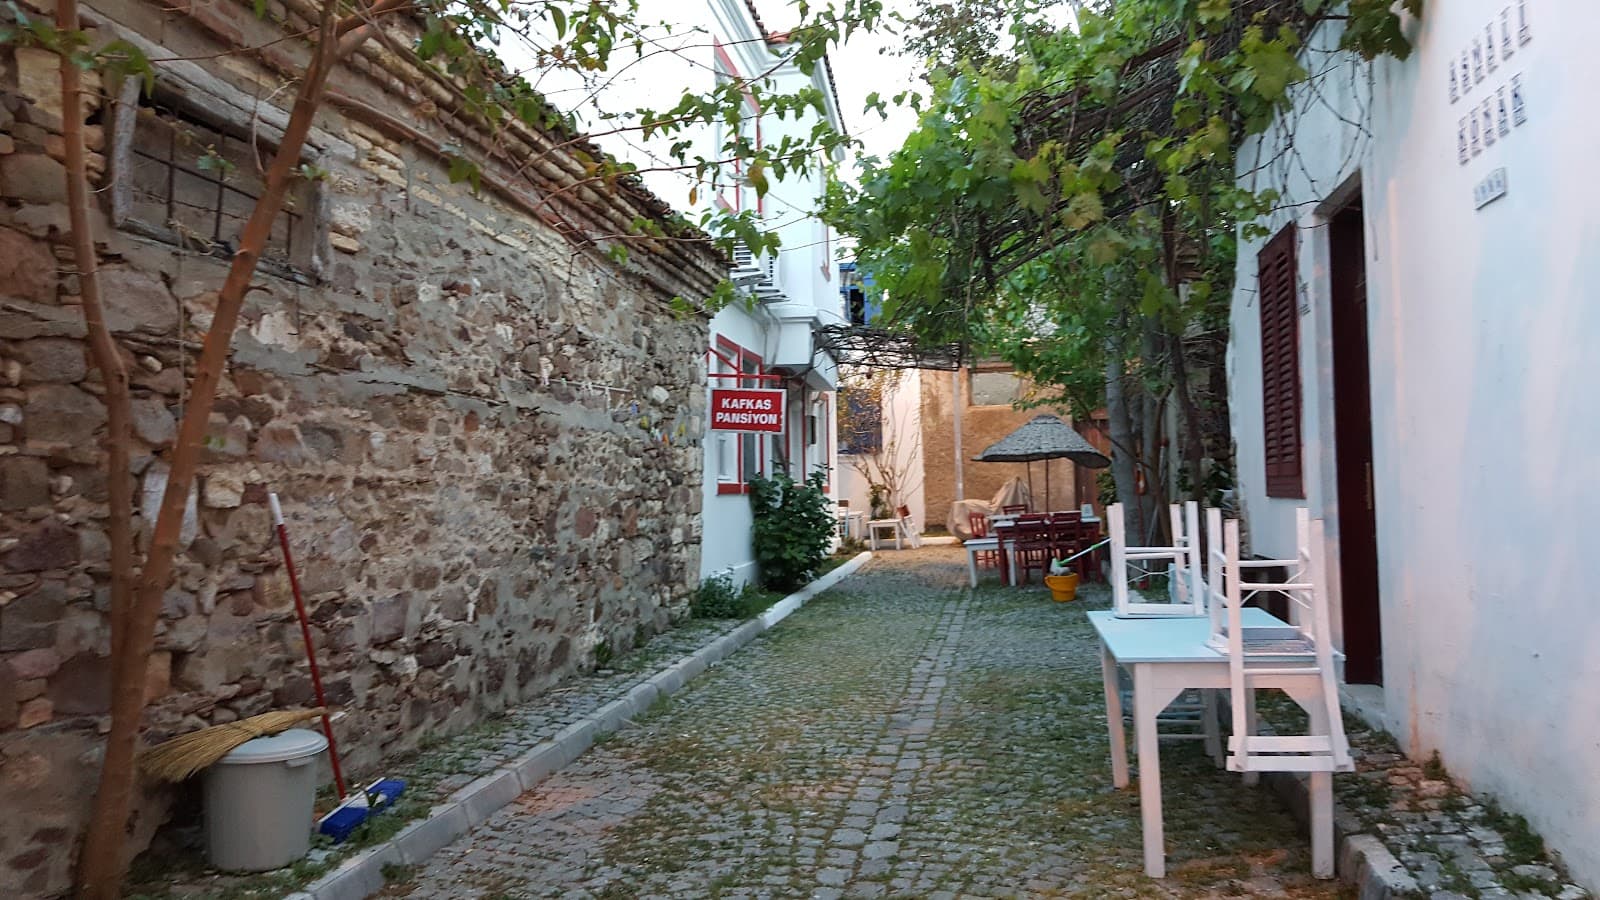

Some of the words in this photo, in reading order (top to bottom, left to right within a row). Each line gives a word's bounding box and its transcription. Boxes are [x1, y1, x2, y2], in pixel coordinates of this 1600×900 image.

[1457, 71, 1529, 166] KONAK
[721, 398, 772, 410] KAFKAS
[716, 410, 777, 424] PANSİYON
